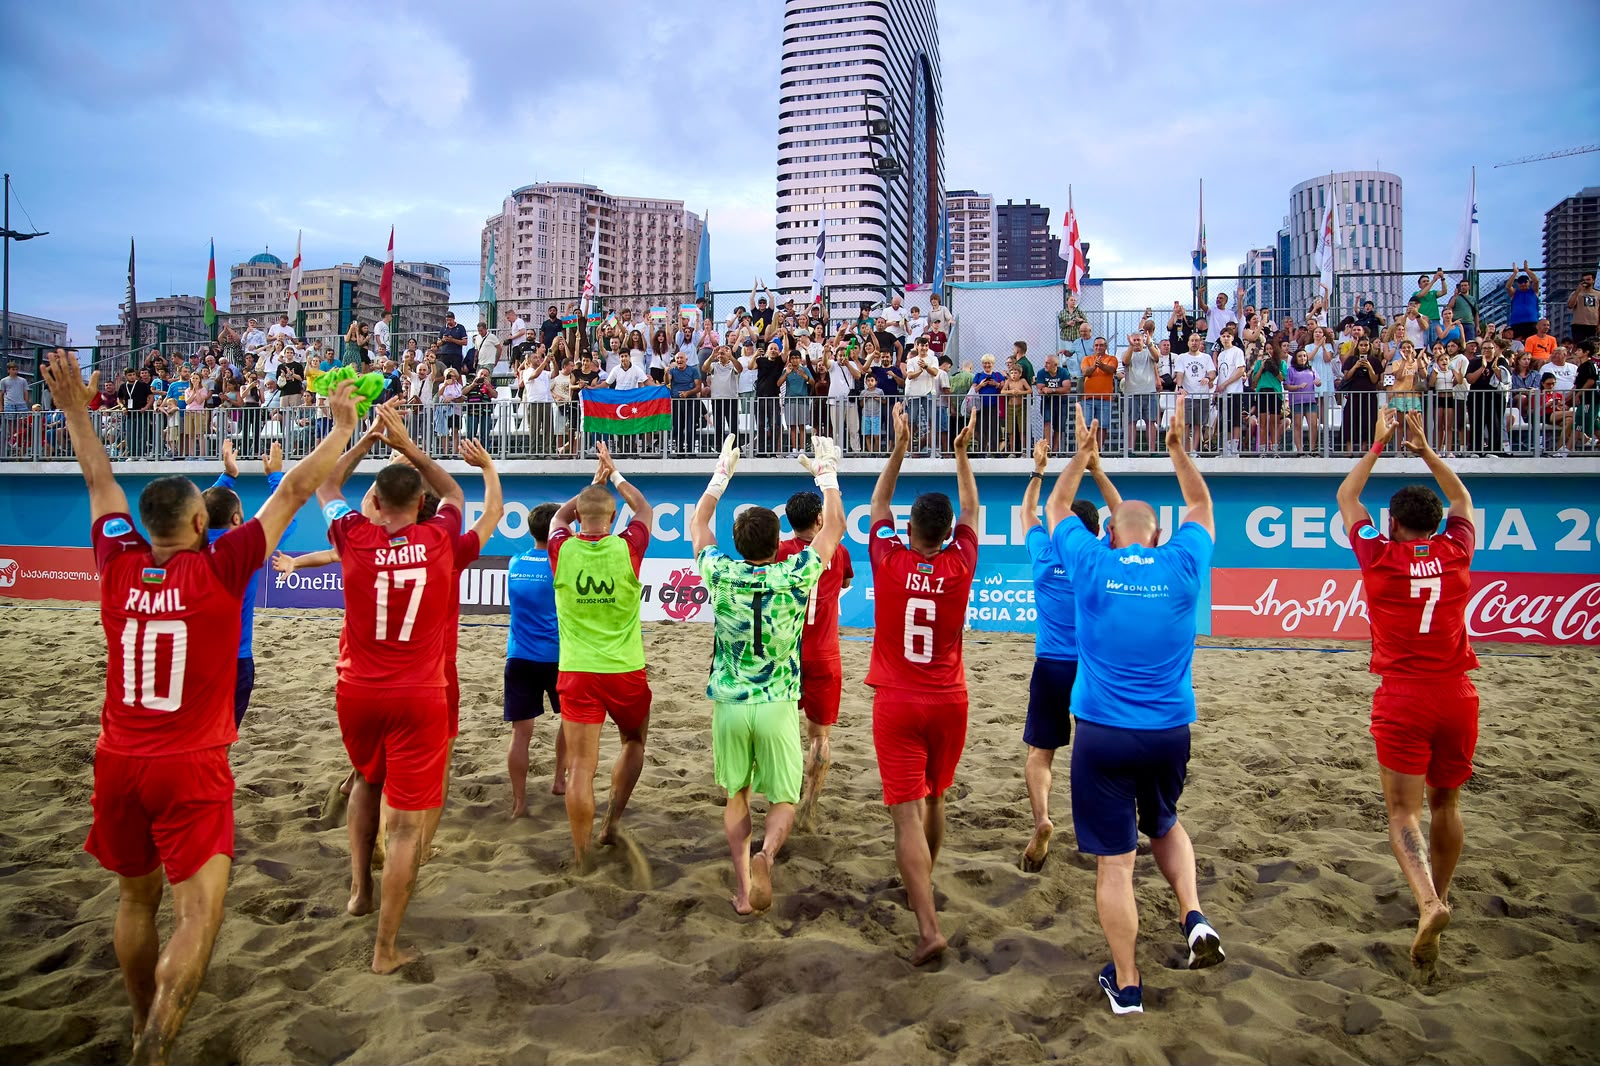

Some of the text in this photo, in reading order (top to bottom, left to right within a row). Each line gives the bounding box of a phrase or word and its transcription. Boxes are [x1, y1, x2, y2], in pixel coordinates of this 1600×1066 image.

[375, 543, 427, 566] SABIR
[20, 569, 92, 580] საქართველოს
[905, 572, 945, 594] ISA.Z
[1123, 584, 1149, 592] BONA
[125, 587, 187, 614] RAMIL
[373, 567, 427, 642] 17
[1410, 577, 1441, 634] 7
[903, 597, 936, 664] 6
[121, 617, 188, 712] 10
